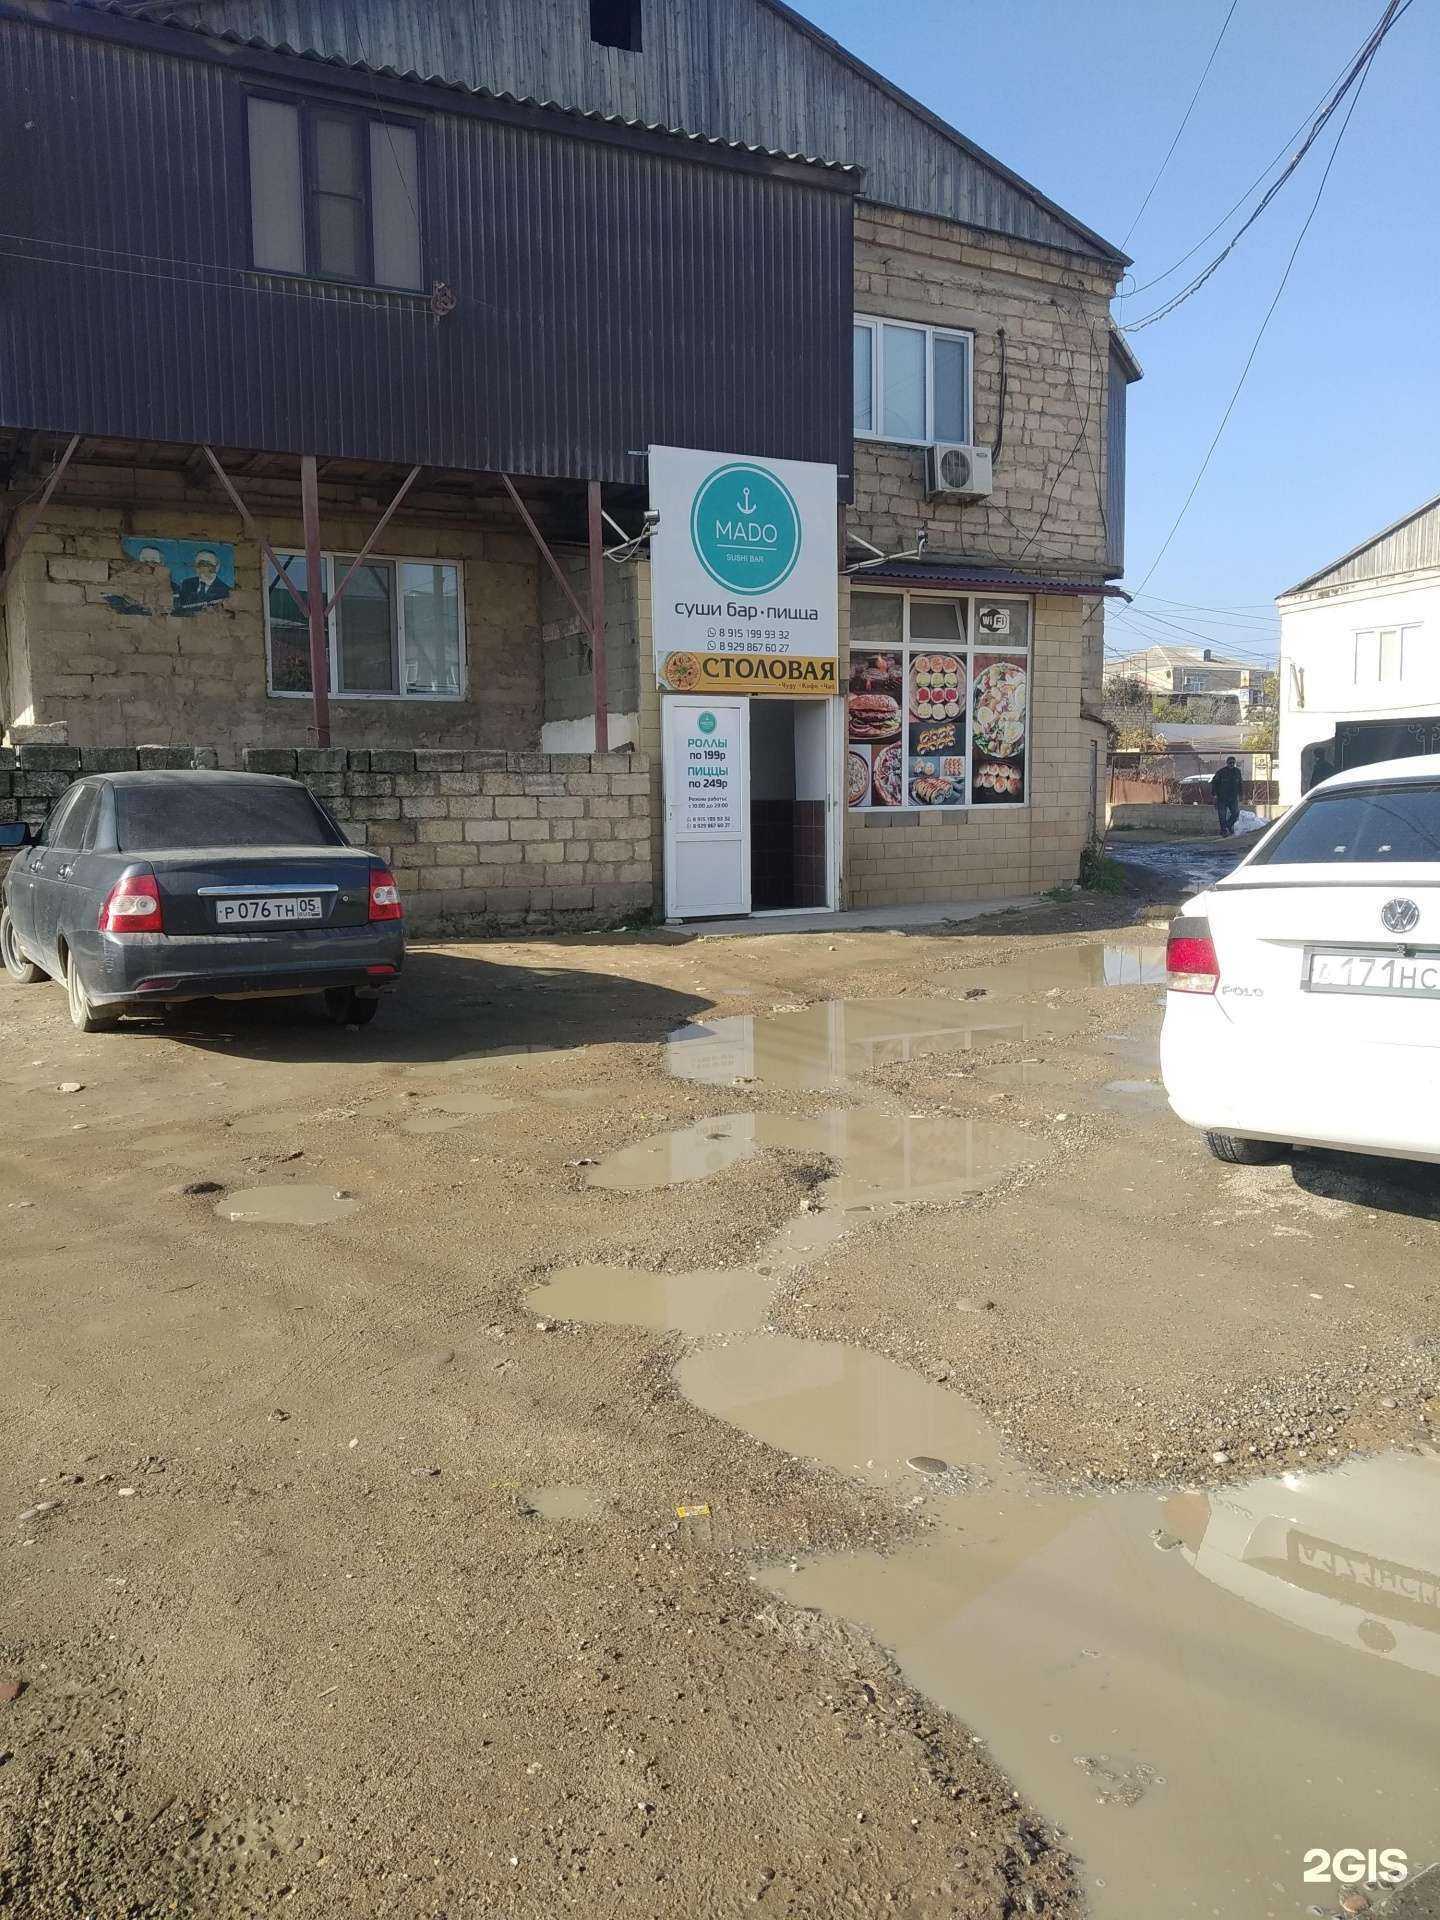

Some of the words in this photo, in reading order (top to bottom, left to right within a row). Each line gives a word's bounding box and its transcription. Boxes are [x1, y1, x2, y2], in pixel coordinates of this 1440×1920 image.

[716, 520, 777, 543] MADO
[726, 554, 748, 562] SUSHI
[749, 555, 764, 563] BAR
[675, 602, 721, 618] суши
[727, 602, 757, 620] бар
[767, 607, 818, 620] пицца
[719, 629, 725, 637] 8
[727, 629, 743, 638] 915
[747, 629, 762, 639] 199
[764, 630, 776, 639] 93
[778, 631, 790, 639] 32
[719, 642, 725, 650] 8
[727, 642, 745, 651] 929
[747, 643, 763, 652] 867
[766, 643, 777, 652] 60
[779, 644, 790, 653] 27
[702, 657, 835, 681] СТОЛОВАЯ
[688, 739, 727, 748] РОЛЛЫ
[690, 752, 702, 760] по
[704, 750, 726, 761] 199р
[688, 767, 728, 777] ПИЦЦЫ
[689, 780, 701, 788] по
[703, 779, 728, 789] 249р
[224, 902, 295, 920] Р076ТН
[300, 899, 315, 912] 05
